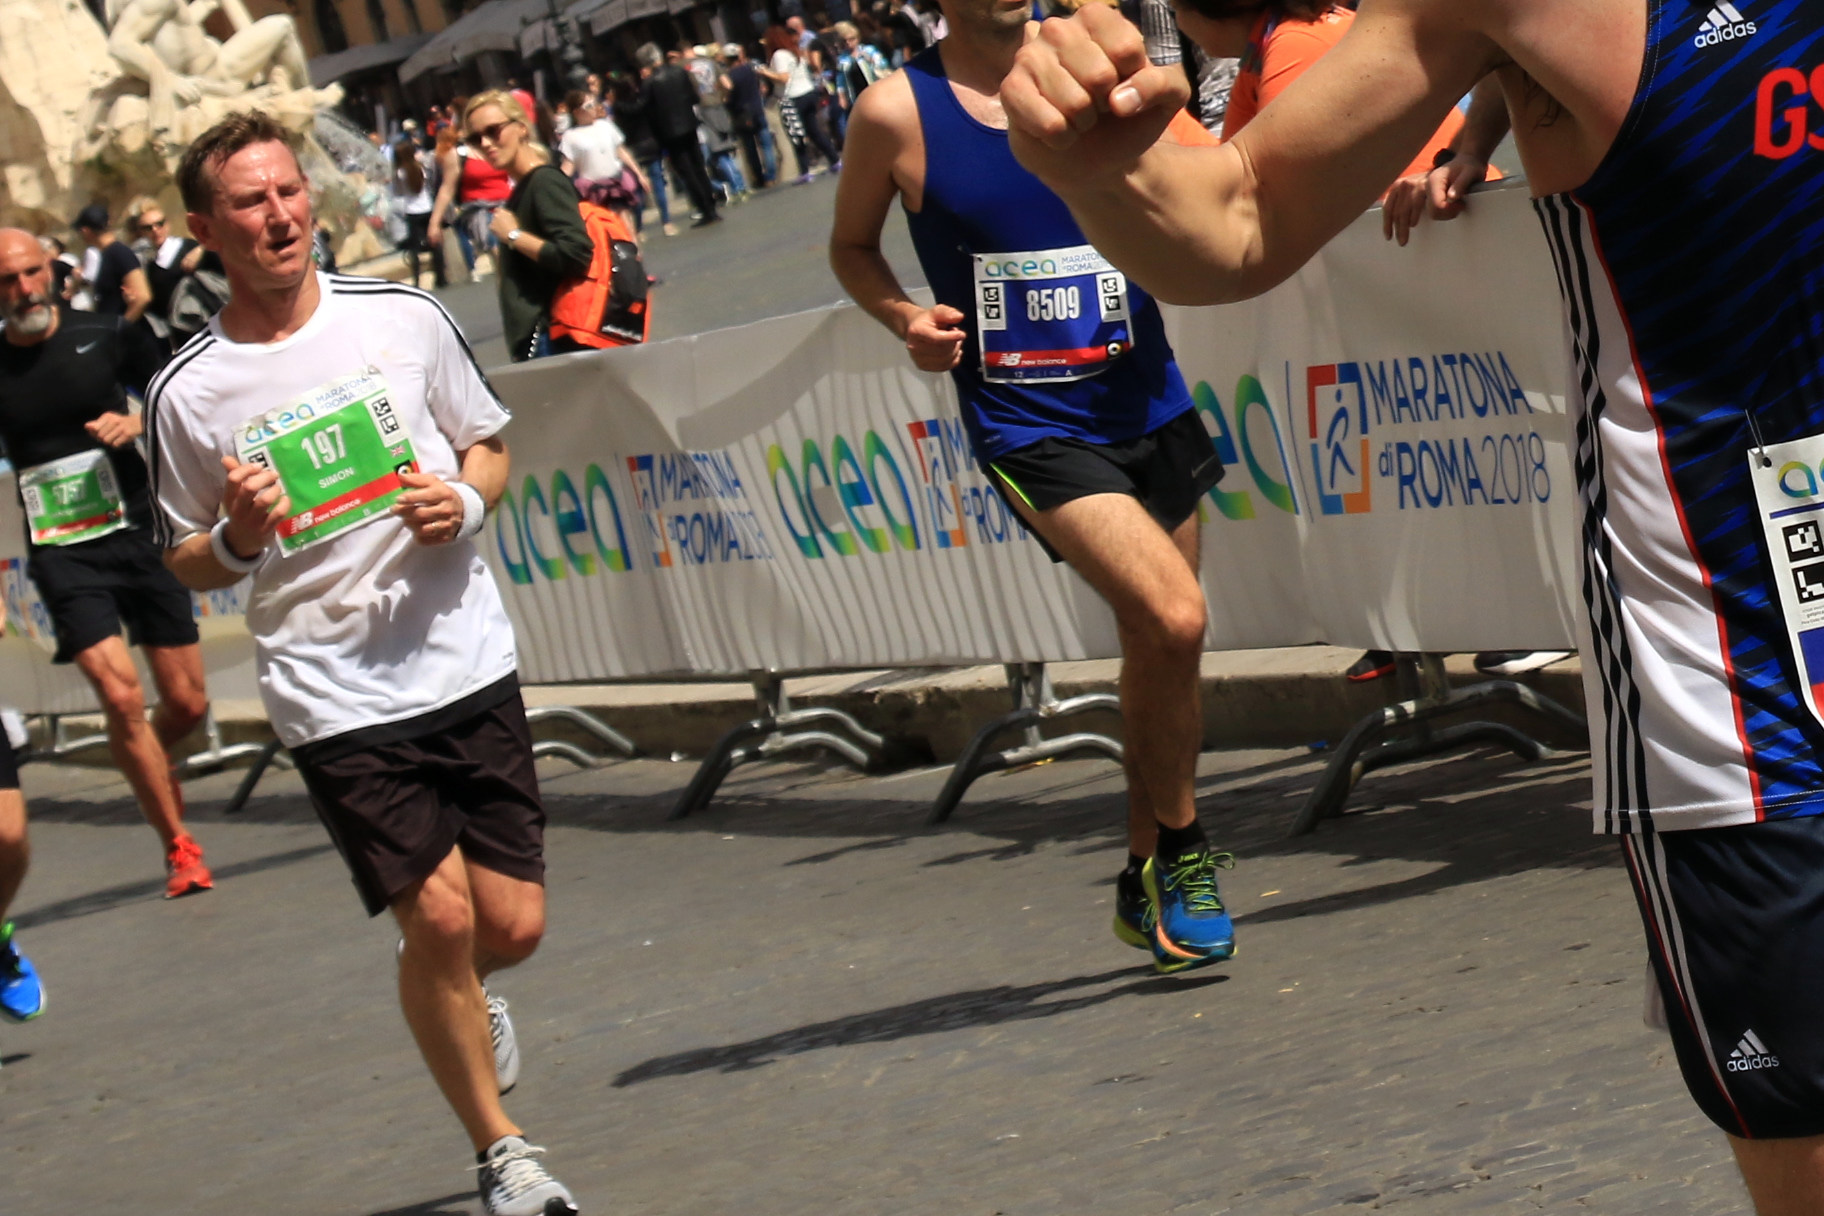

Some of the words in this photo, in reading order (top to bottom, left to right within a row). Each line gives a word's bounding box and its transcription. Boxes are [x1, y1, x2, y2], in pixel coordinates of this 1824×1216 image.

[1694, 20, 1757, 49] adidas
[985, 258, 1057, 278] acea
[1026, 286, 1081, 322] 8509
[1364, 351, 1534, 426] MARATONA
[301, 423, 347, 470] 197
[1379, 443, 1394, 477] di
[318, 467, 355, 489] SIMON
[767, 430, 922, 559] acea
[496, 463, 632, 584] acea
[1726, 1054, 1780, 1072] adidas
